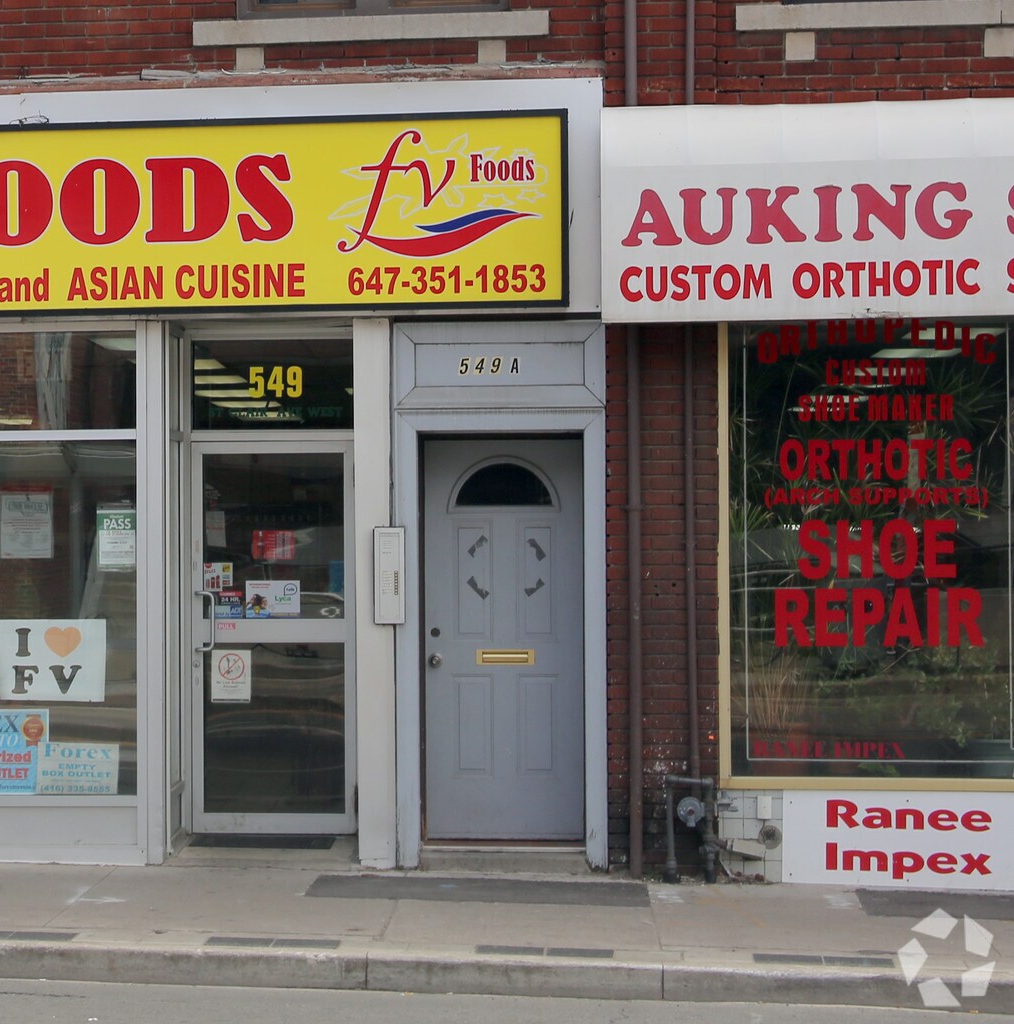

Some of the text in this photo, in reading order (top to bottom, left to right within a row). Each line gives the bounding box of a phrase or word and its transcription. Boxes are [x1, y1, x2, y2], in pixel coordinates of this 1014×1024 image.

[469, 153, 535, 182] Foods
[621, 181, 973, 247] AUKING
[67, 265, 164, 301] ASIAN
[175, 263, 306, 299] CUISINE
[348, 264, 546, 295] 647-351-1853
[620, 263, 772, 302] CUSTOM
[792, 258, 981, 299] ORTHOTIC
[757, 317, 997, 364] ORTHOPEDIC
[248, 365, 303, 398] 549
[825, 358, 927, 387] CUSTOM
[306, 406, 343, 417] WEST
[798, 393, 955, 422] SHOE MAKER
[779, 438, 973, 481] ORTHOTIC
[764, 487, 989, 509] (ARCH SUPPORTS)
[103, 518, 132, 530] PASS
[797, 519, 957, 580] SHOE
[774, 587, 985, 647] REPAIR
[15, 627, 32, 657] I
[11, 664, 82, 695] FV
[44, 743, 112, 760] Forex
[58, 763, 96, 771] EMPTY
[40, 785, 65, 793] (416)
[68, 770, 111, 778] OUTLET
[826, 798, 993, 832] Ranee
[826, 842, 992, 879] Impex
